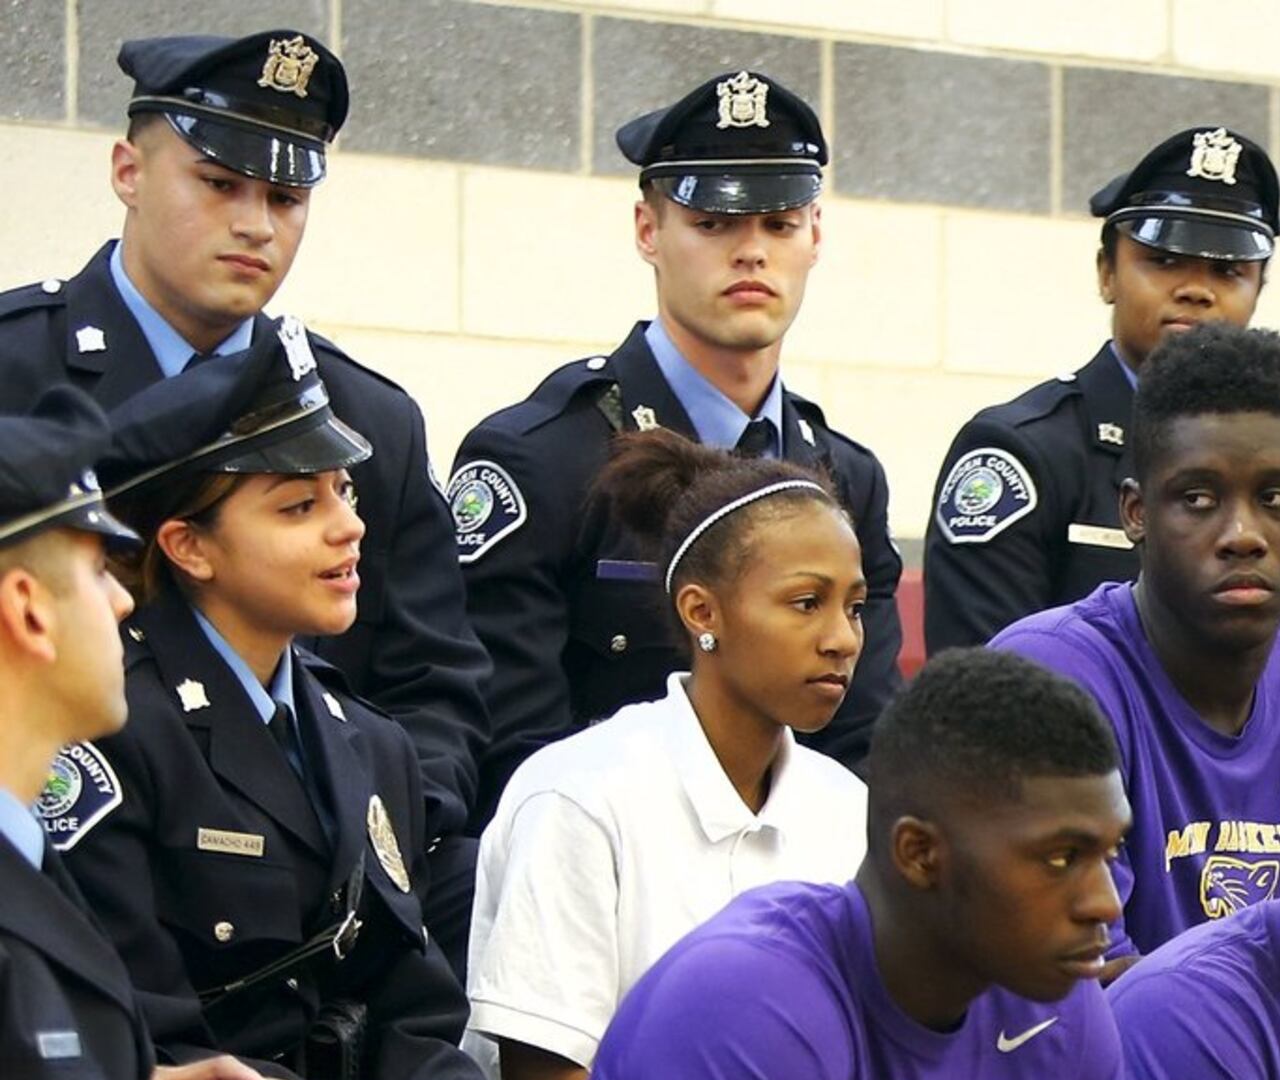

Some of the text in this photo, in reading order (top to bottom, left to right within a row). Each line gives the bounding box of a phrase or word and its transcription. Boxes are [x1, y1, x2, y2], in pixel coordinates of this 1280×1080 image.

[986, 456, 1029, 501] COUNTY
[480, 468, 518, 515] COUNTY
[949, 515, 998, 528] POLICE
[455, 533, 486, 545] LICE
[44, 817, 79, 833] LICE
